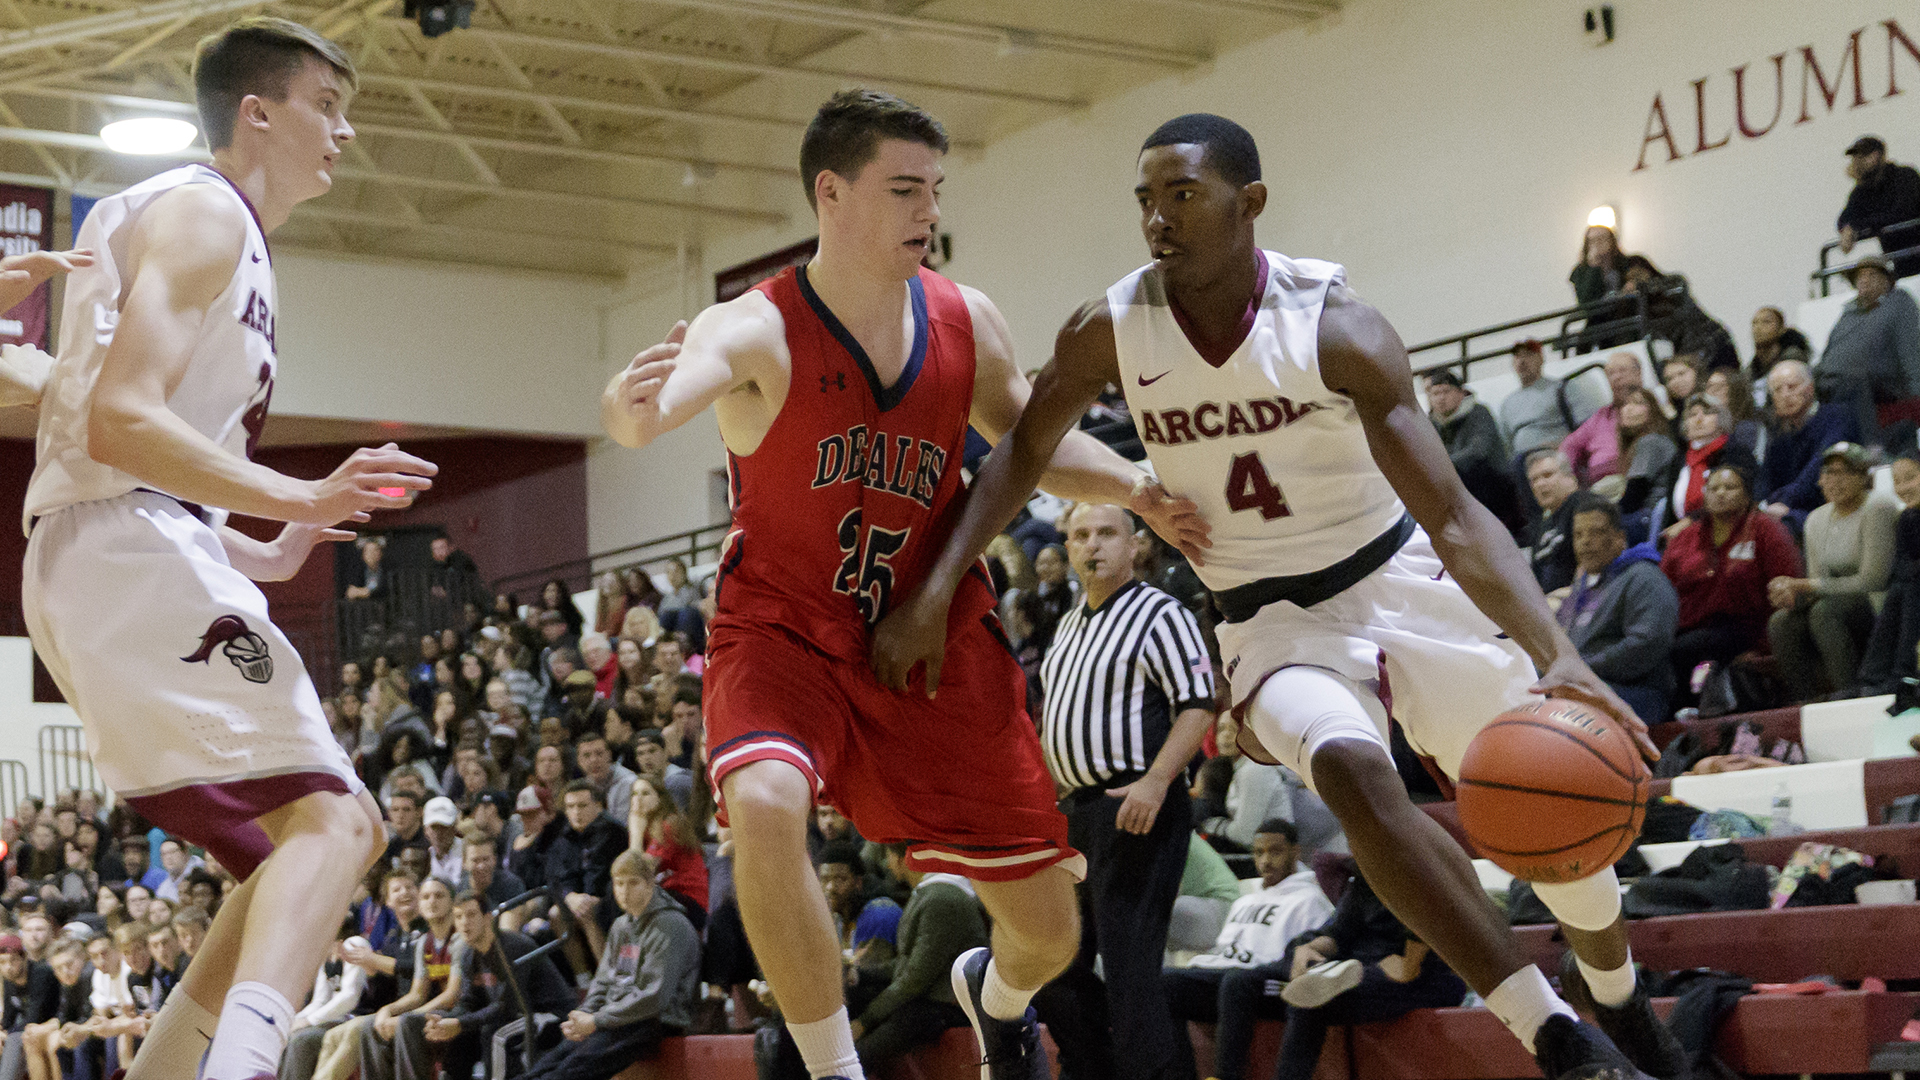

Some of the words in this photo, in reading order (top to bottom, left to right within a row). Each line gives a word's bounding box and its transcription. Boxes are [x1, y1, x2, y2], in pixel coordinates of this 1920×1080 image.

[0, 202, 42, 235] dia
[811, 424, 947, 509] DEALES
[1224, 450, 1294, 523] 4
